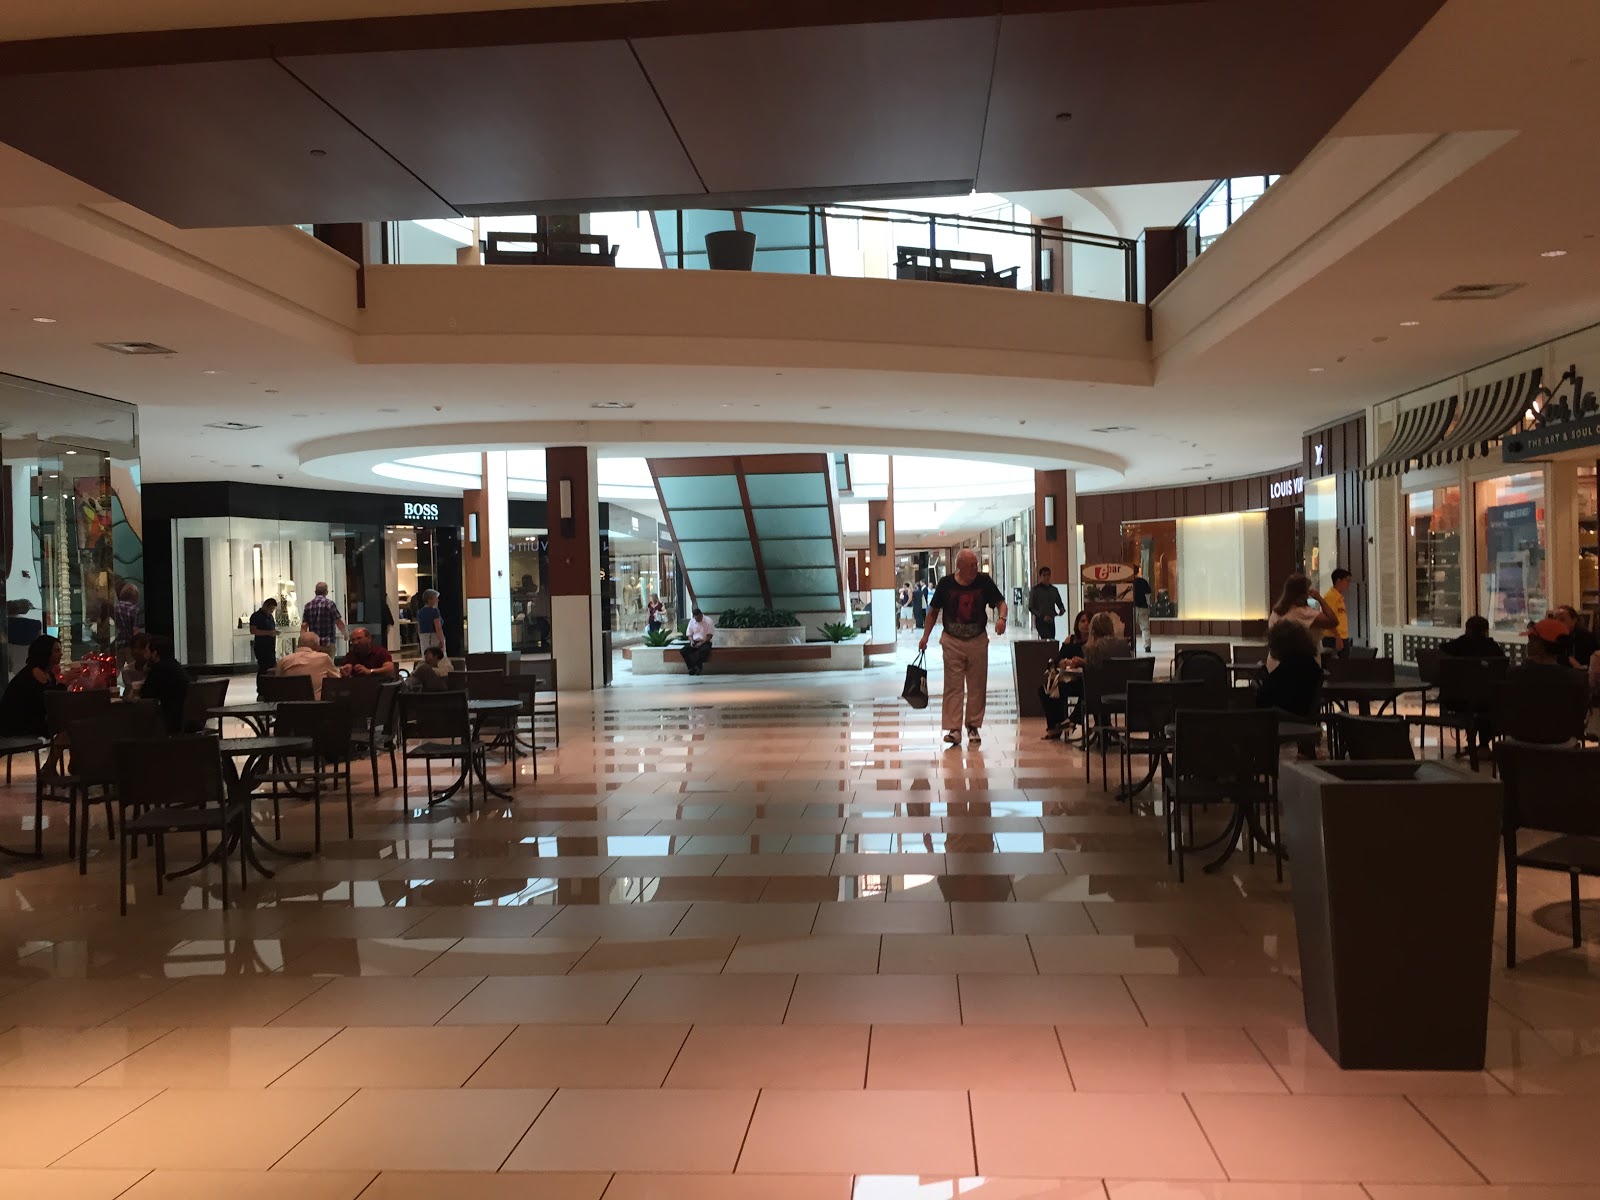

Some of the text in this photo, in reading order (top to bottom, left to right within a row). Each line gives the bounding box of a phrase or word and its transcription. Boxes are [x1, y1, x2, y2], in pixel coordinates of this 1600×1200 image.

[1528, 437, 1542, 448] THE
[1545, 433, 1560, 444] ART
[1571, 426, 1593, 440] SOUL
[1270, 479, 1292, 499] LOUIS
[403, 502, 439, 516] BOSS
